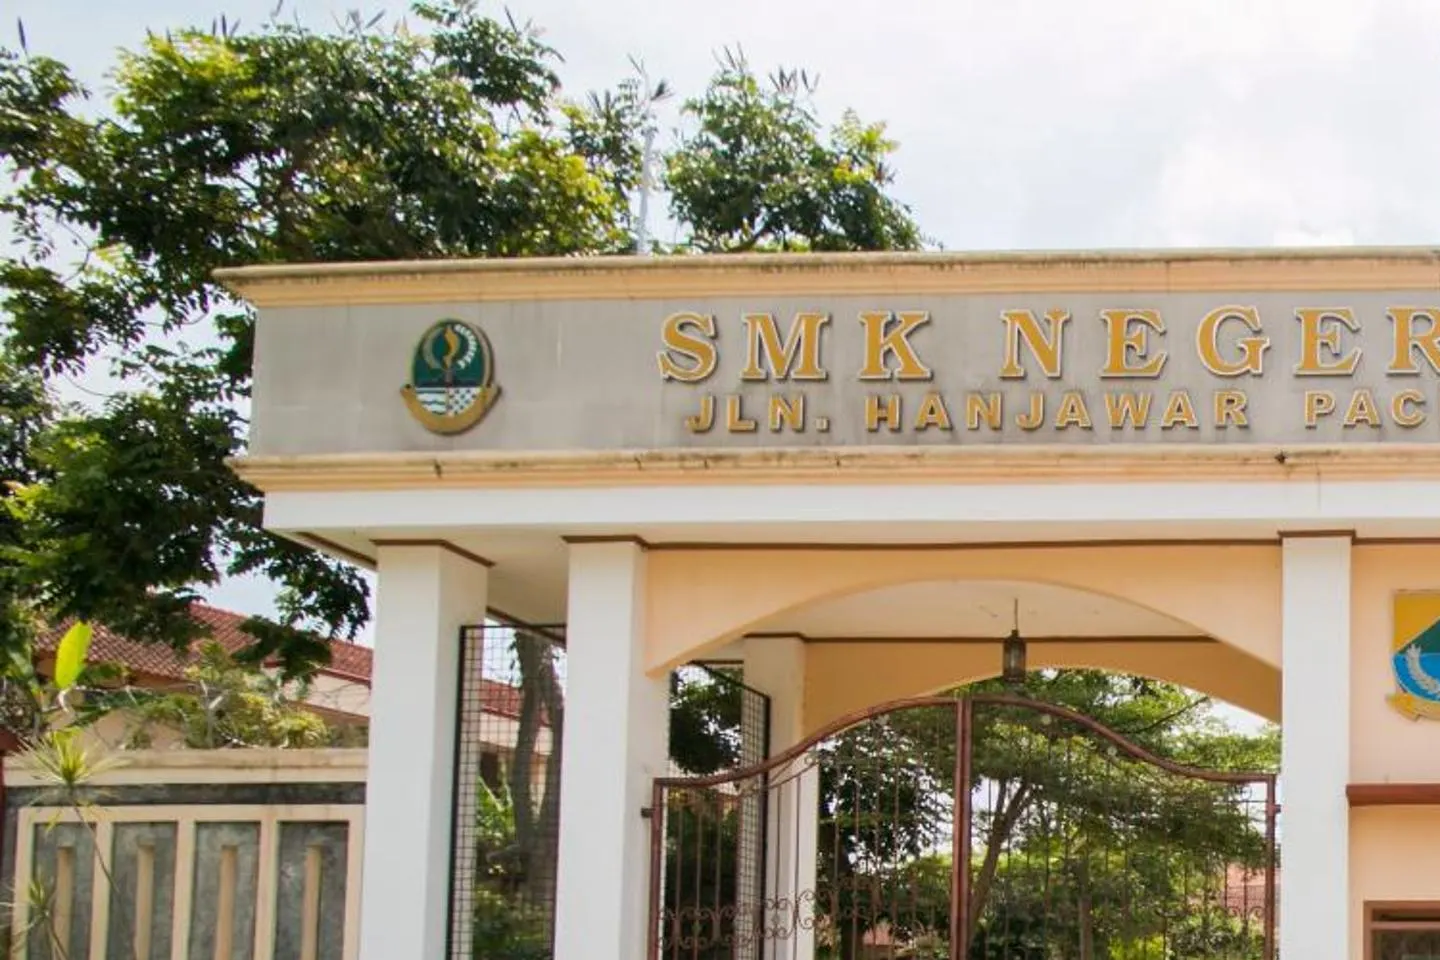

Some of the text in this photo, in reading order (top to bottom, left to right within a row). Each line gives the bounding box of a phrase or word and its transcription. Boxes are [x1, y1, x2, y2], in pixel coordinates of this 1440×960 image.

[659, 309, 934, 381] SMK
[685, 393, 830, 433] JLN.
[864, 390, 1248, 432] HANJAWAR
